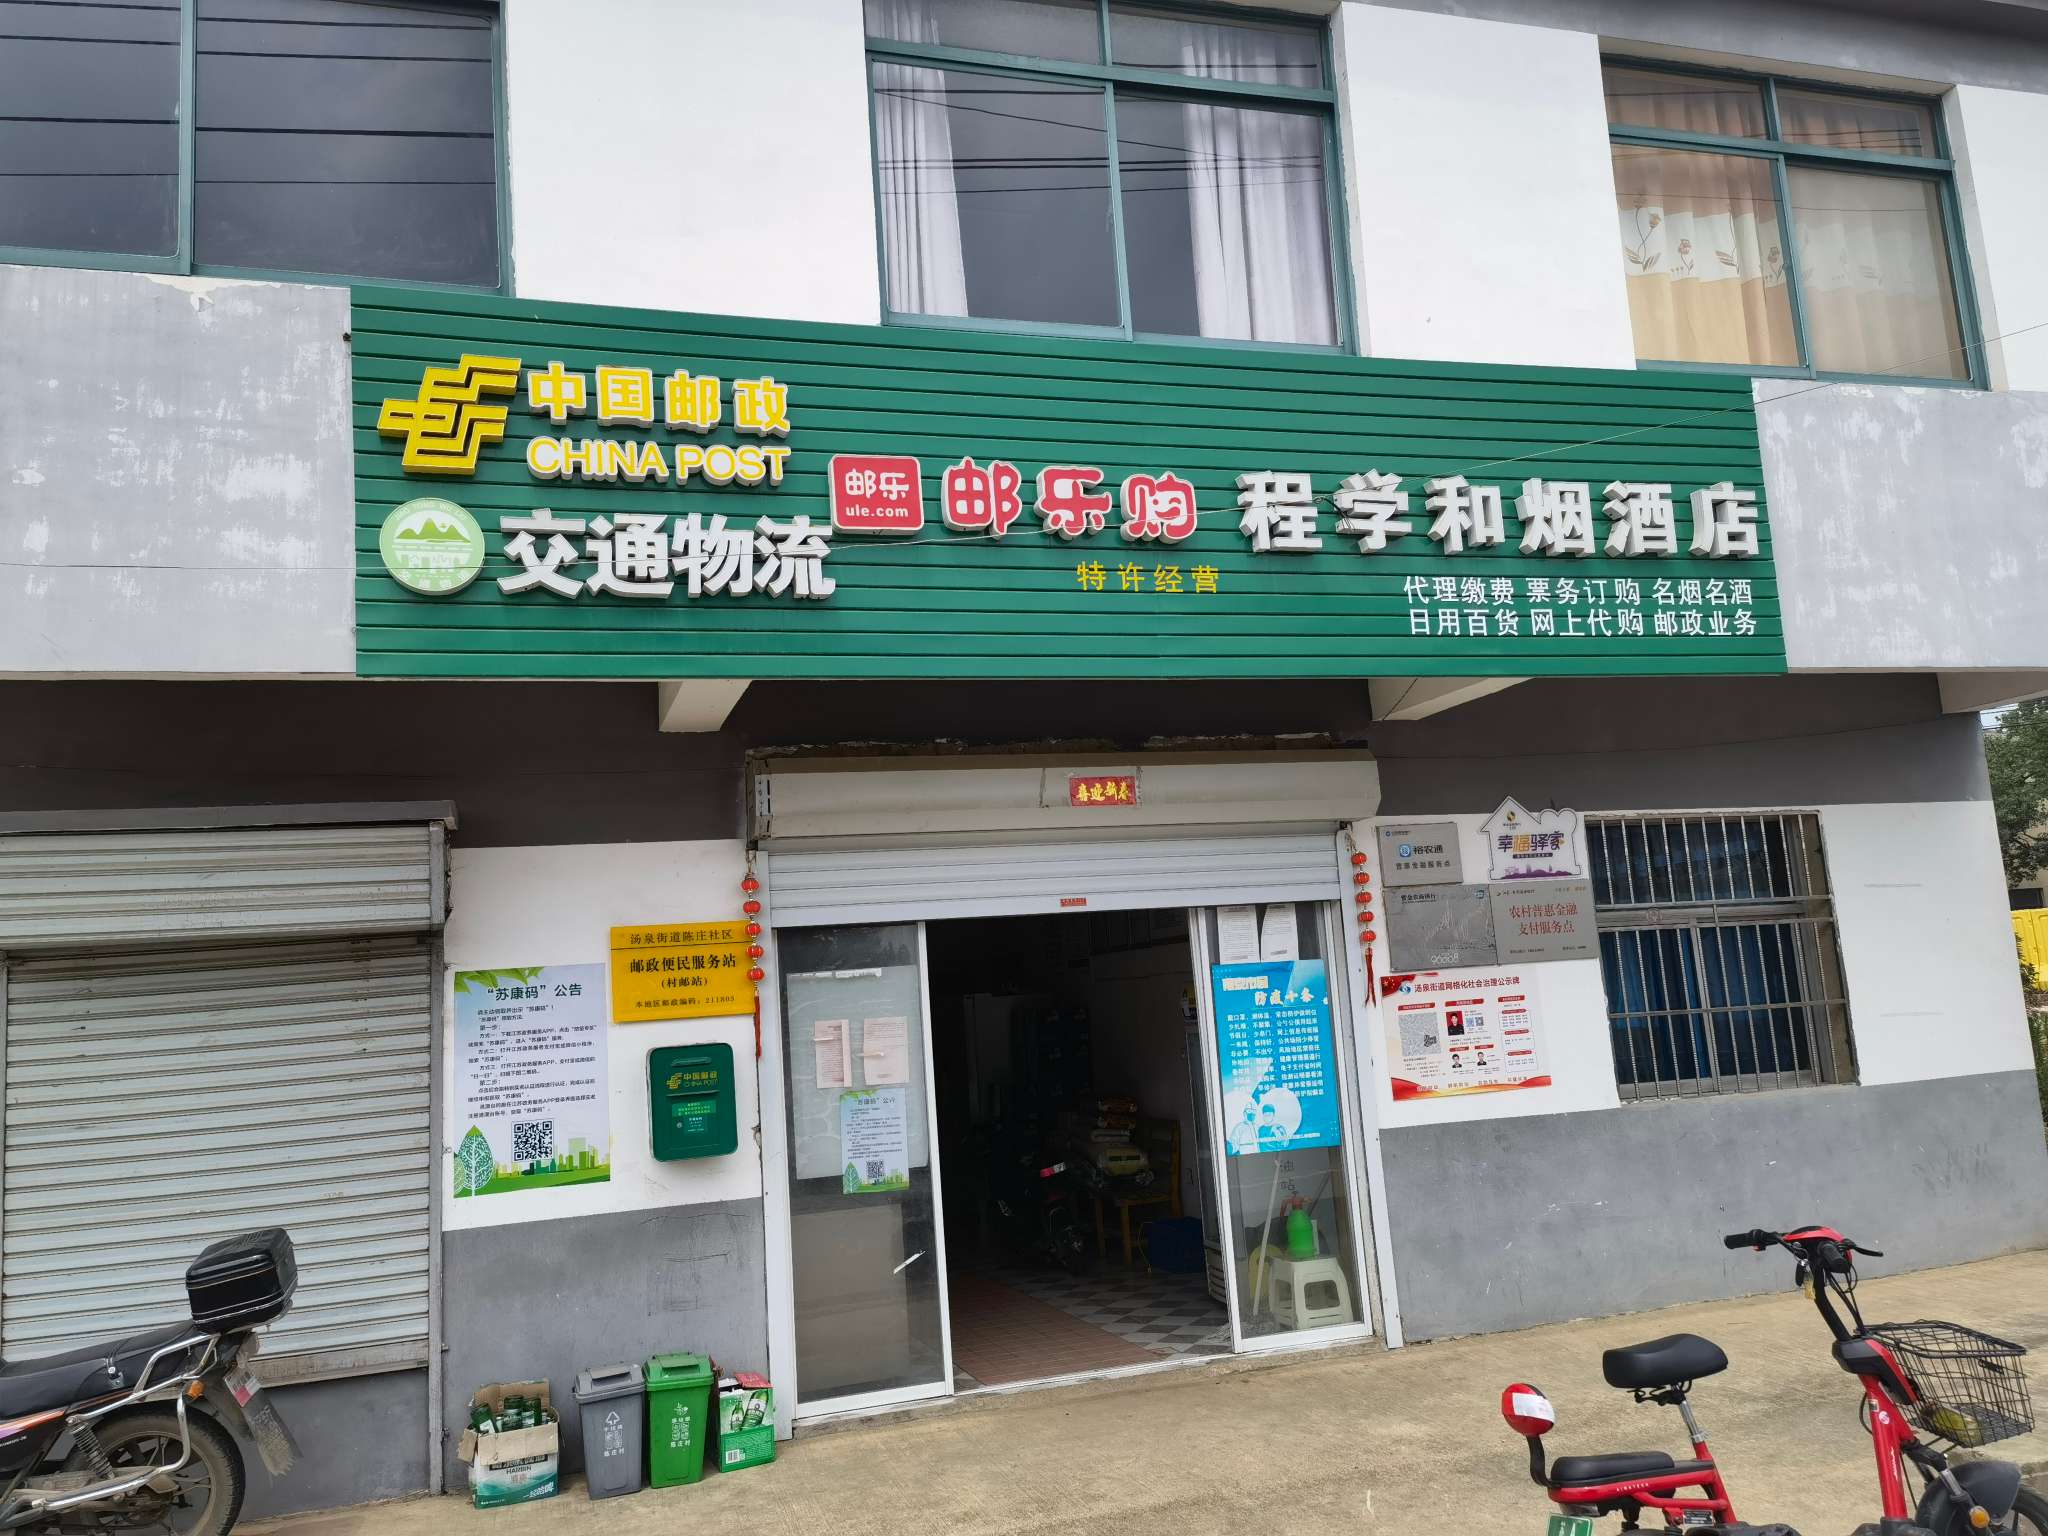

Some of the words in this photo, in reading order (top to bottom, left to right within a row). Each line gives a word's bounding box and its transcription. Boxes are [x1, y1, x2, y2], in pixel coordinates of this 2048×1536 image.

[527, 361, 791, 437] 中国邮政
[526, 436, 669, 484] CHINA
[676, 444, 791, 486] POST
[845, 468, 910, 500] 邮乐
[941, 456, 1198, 543] 邮乐购
[845, 504, 909, 518] ule.com
[1237, 469, 1760, 557] 程学和烟酒店
[497, 508, 837, 600] 交通物流
[1075, 560, 1220, 593] 特许经营
[1403, 575, 1515, 606] 代理缴费
[1525, 577, 1641, 606] 票务订购
[1651, 577, 1753, 606] 名烟名酒
[1409, 608, 1519, 636] 日用百货
[1530, 608, 1645, 636] 网上代购
[1653, 608, 1757, 637] 邮政业务
[630, 929, 734, 945] 汤泉街道陈庄社区
[630, 953, 737, 973] 邮政便民服务站
[506, 1465, 532, 1475] HARBIN
